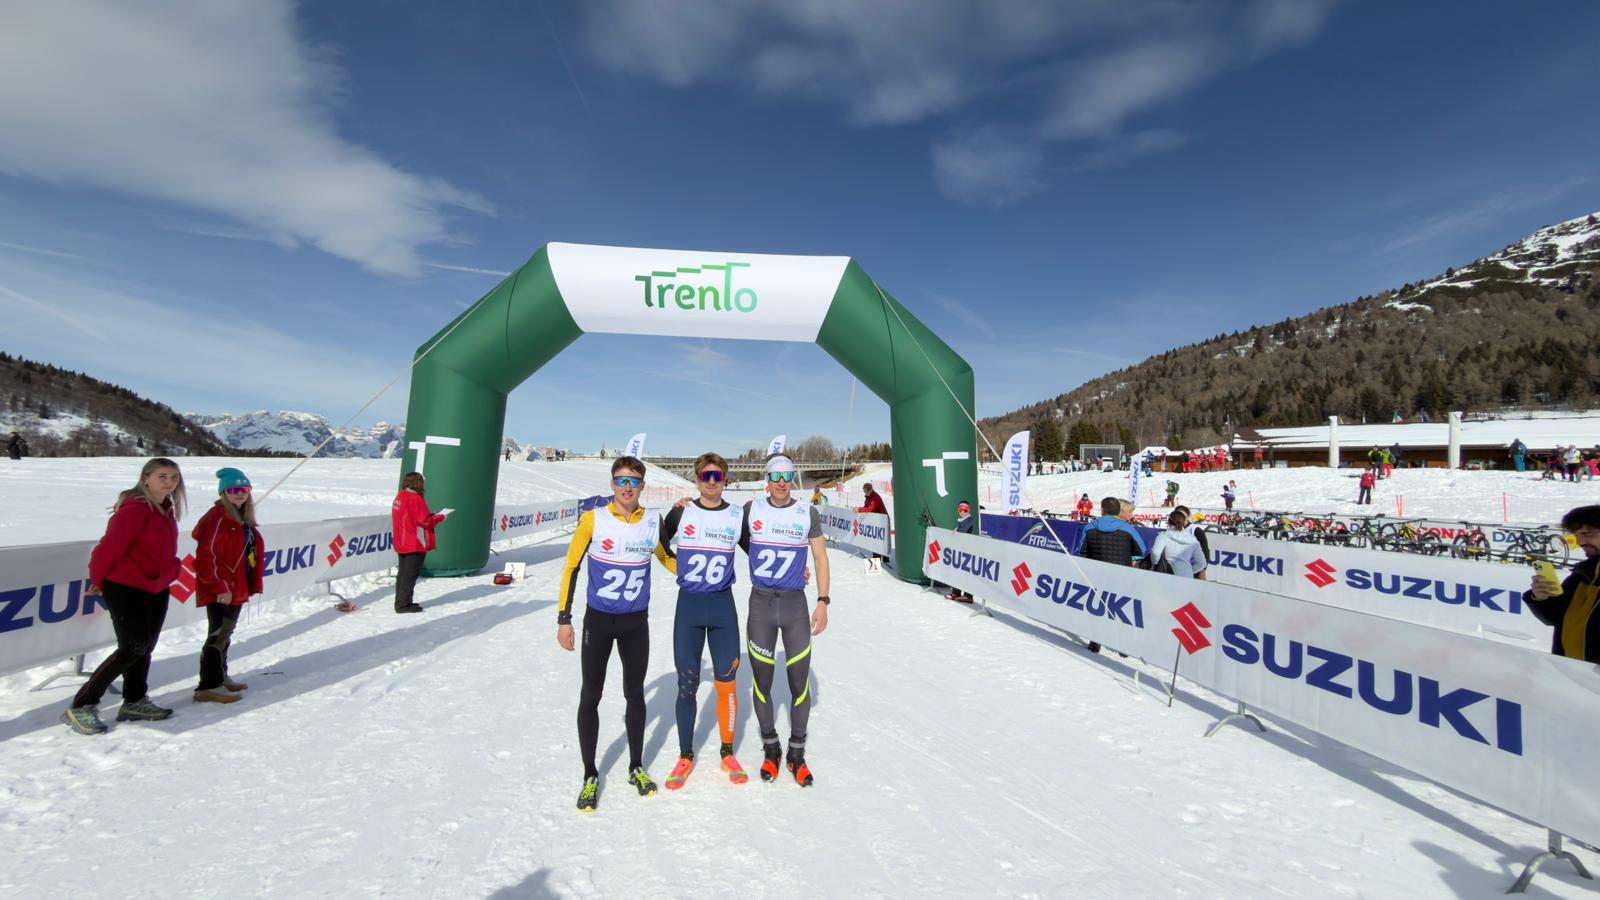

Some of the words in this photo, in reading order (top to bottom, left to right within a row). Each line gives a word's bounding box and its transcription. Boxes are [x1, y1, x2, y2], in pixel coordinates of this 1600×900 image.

[634, 261, 758, 313] Trento
[1009, 443, 1022, 506] SUZUKI
[508, 514, 535, 529] SUZUKI
[541, 510, 560, 523] SUZUKI
[831, 516, 852, 532] SUZUKI
[858, 522, 886, 541] SUZUKI
[1028, 534, 1047, 548] FITRI
[684, 554, 728, 585] 26
[754, 549, 797, 579] 27
[943, 547, 1000, 582] SUZUKI
[597, 568, 647, 601] 25
[1034, 572, 1145, 629] SUZUKI
[1345, 568, 1523, 615] SUZUKI
[1221, 623, 1523, 756] SUZUKI
